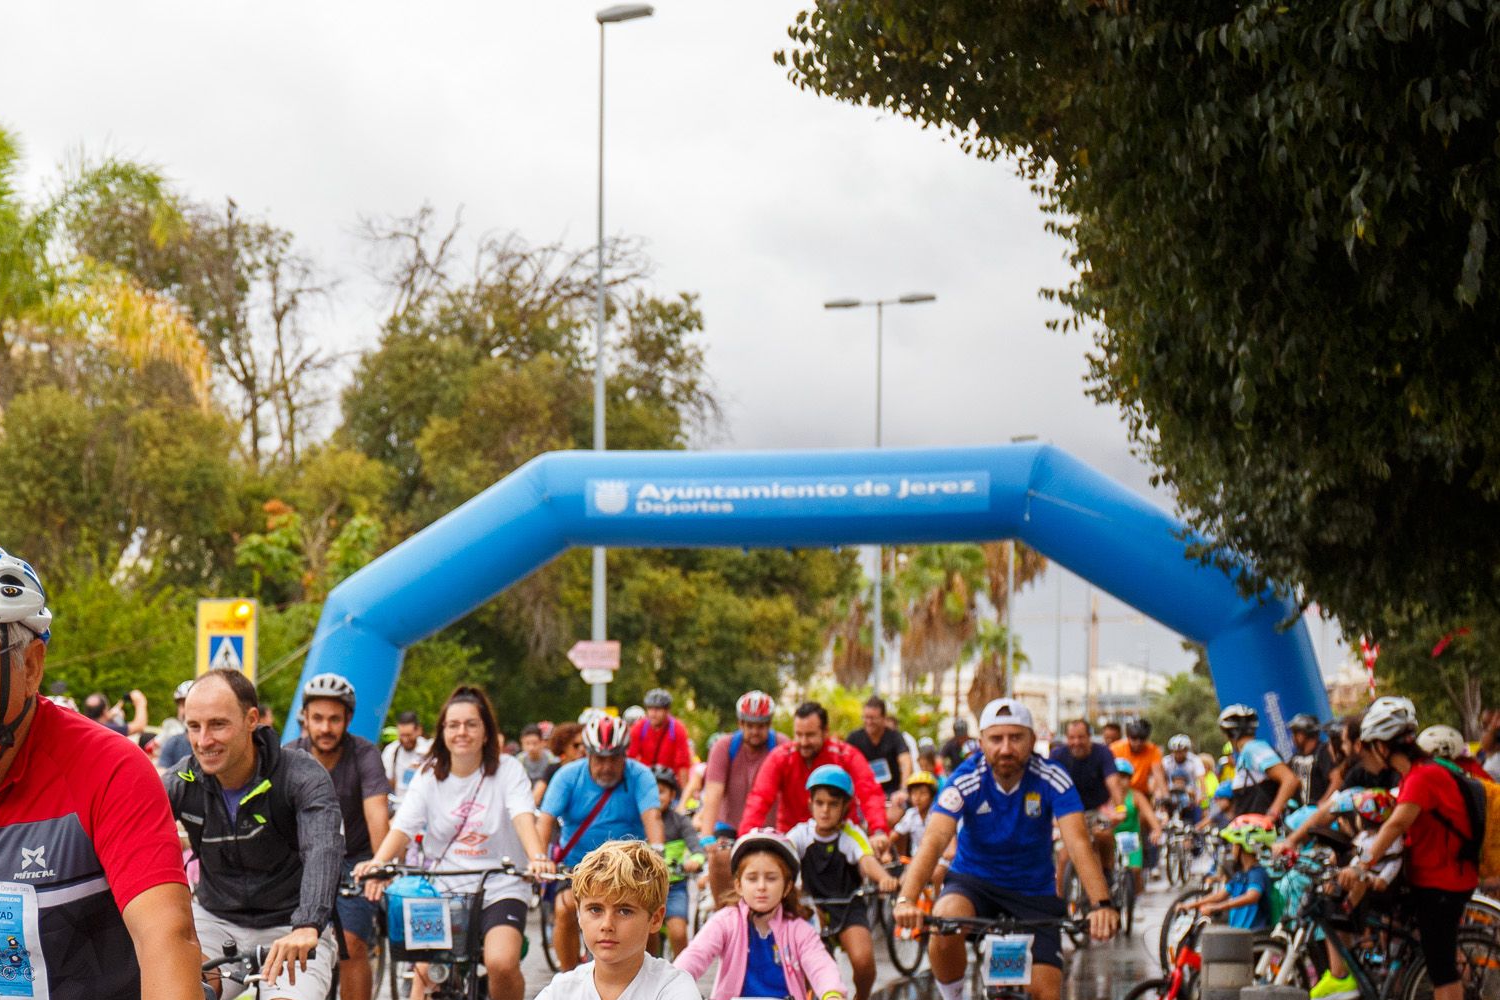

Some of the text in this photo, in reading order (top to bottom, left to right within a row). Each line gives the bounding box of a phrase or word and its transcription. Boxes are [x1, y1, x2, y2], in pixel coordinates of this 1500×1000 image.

[638, 477, 977, 504] Ayuntamiento de Jerez
[634, 499, 735, 515] Deportes
